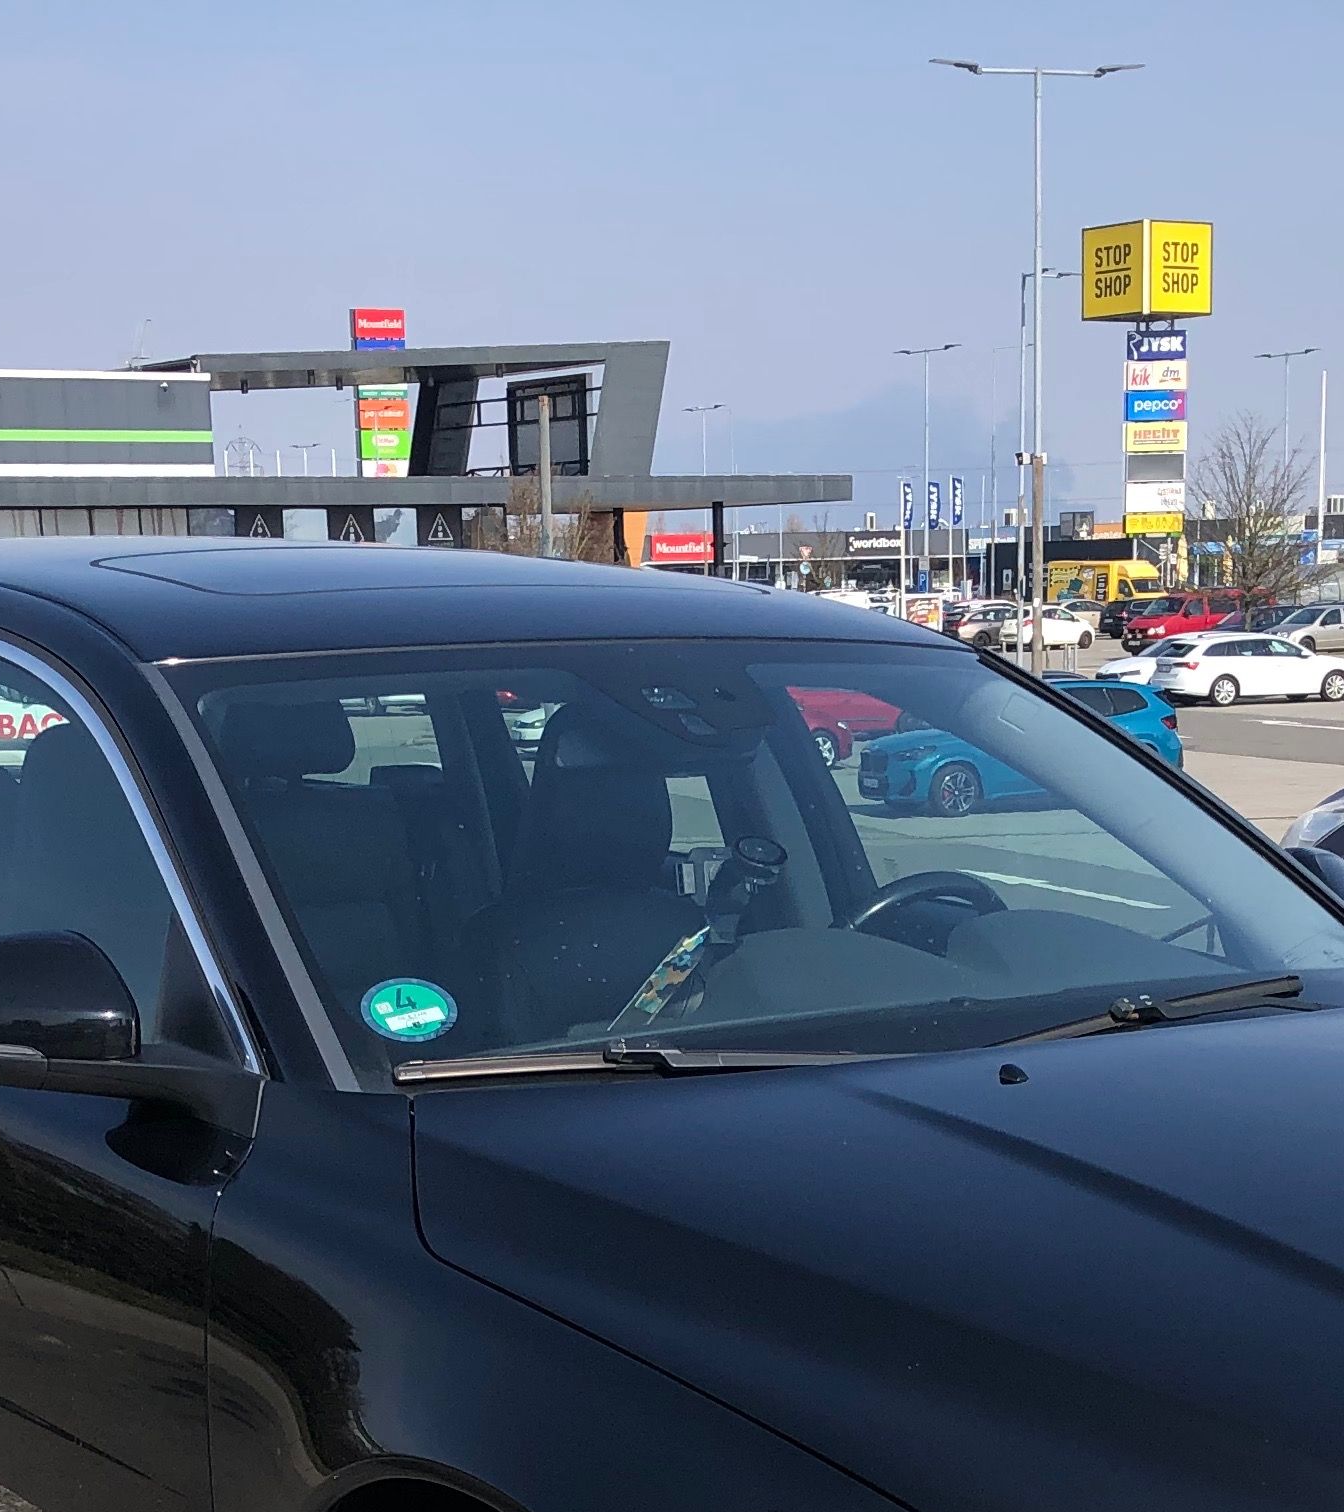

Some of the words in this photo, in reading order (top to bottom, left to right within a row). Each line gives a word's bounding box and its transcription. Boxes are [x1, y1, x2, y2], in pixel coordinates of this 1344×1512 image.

[1095, 243, 1131, 268] STOP
[1162, 241, 1199, 263] STOP
[1095, 274, 1131, 298] SHOP
[1162, 272, 1199, 294] SHOP
[1139, 336, 1184, 352] JYSK
[1162, 366, 1180, 378] dm
[1134, 399, 1180, 413] pepco
[395, 987, 418, 1010] 4
